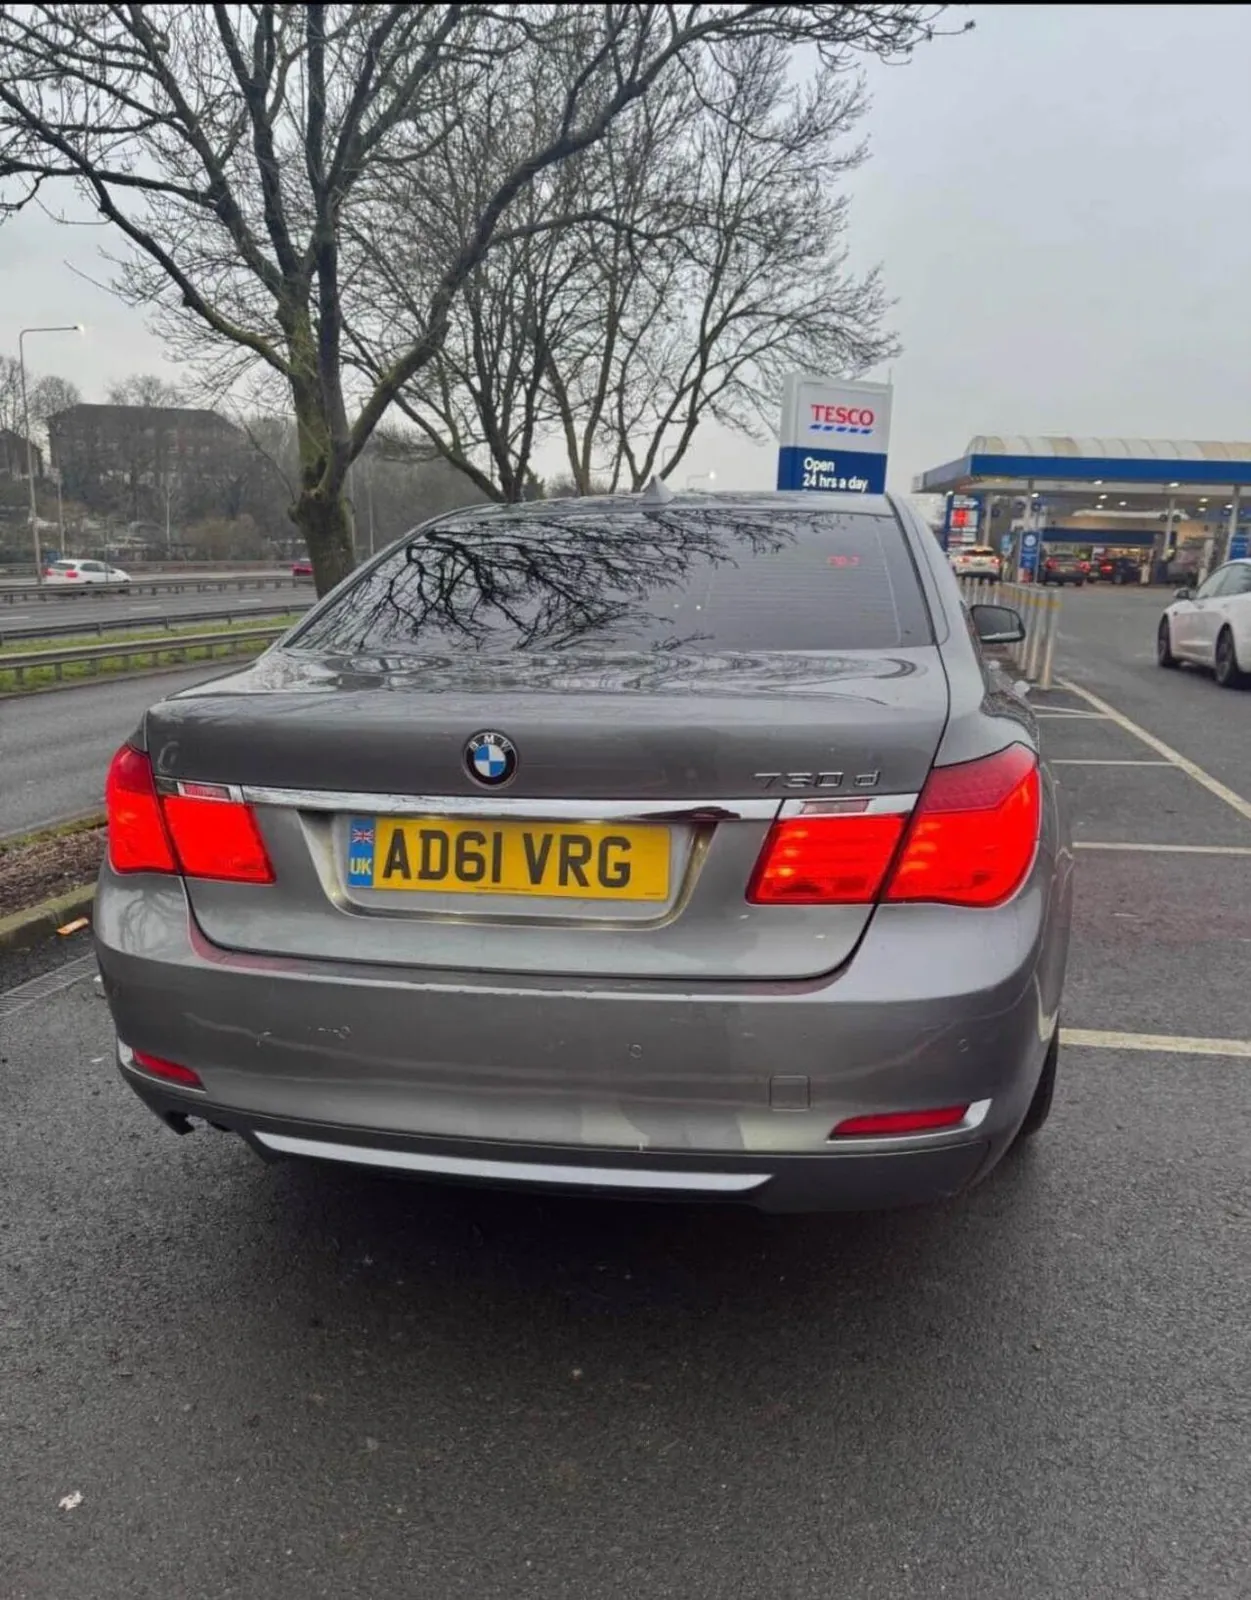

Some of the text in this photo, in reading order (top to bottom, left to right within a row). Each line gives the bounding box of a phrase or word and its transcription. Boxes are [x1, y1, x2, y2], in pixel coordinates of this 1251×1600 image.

[810, 404, 875, 427] TESCO
[803, 457, 835, 474] Open
[802, 473, 868, 493] 24 hrs a day
[468, 734, 512, 752] BMW
[753, 770, 880, 789] 730 d
[349, 857, 372, 877] UK
[382, 827, 632, 889] AD61 VRG
